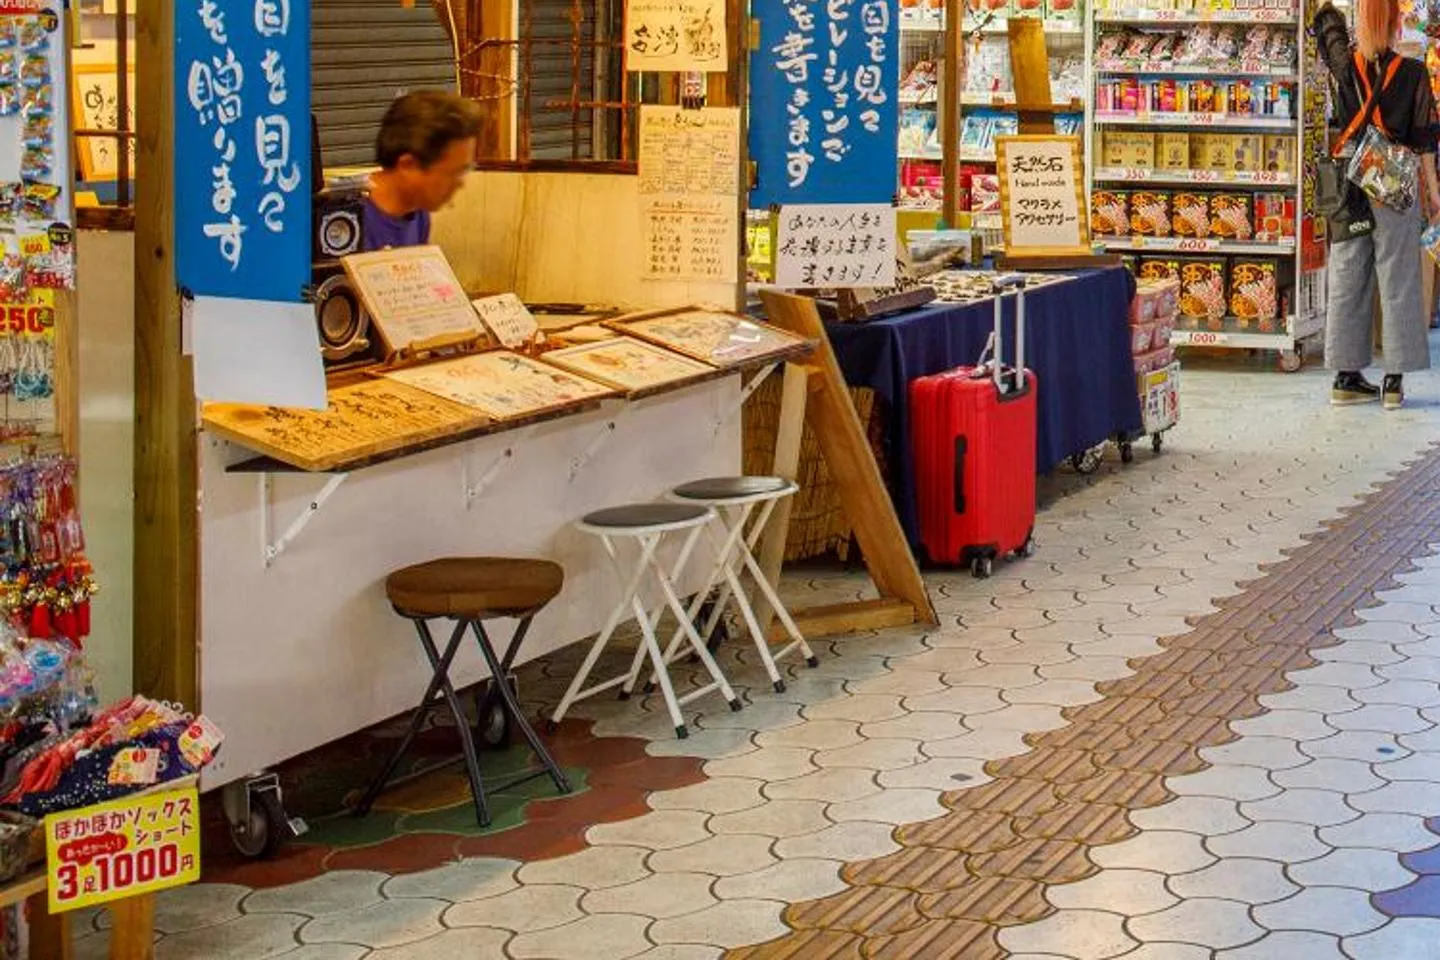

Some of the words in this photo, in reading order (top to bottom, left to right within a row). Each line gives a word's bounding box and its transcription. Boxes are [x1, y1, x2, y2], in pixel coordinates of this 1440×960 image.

[1012, 155, 1063, 173] 天然石
[1017, 199, 1062, 210] マクラメ
[0, 306, 44, 333] 50
[136, 819, 193, 846] ショート
